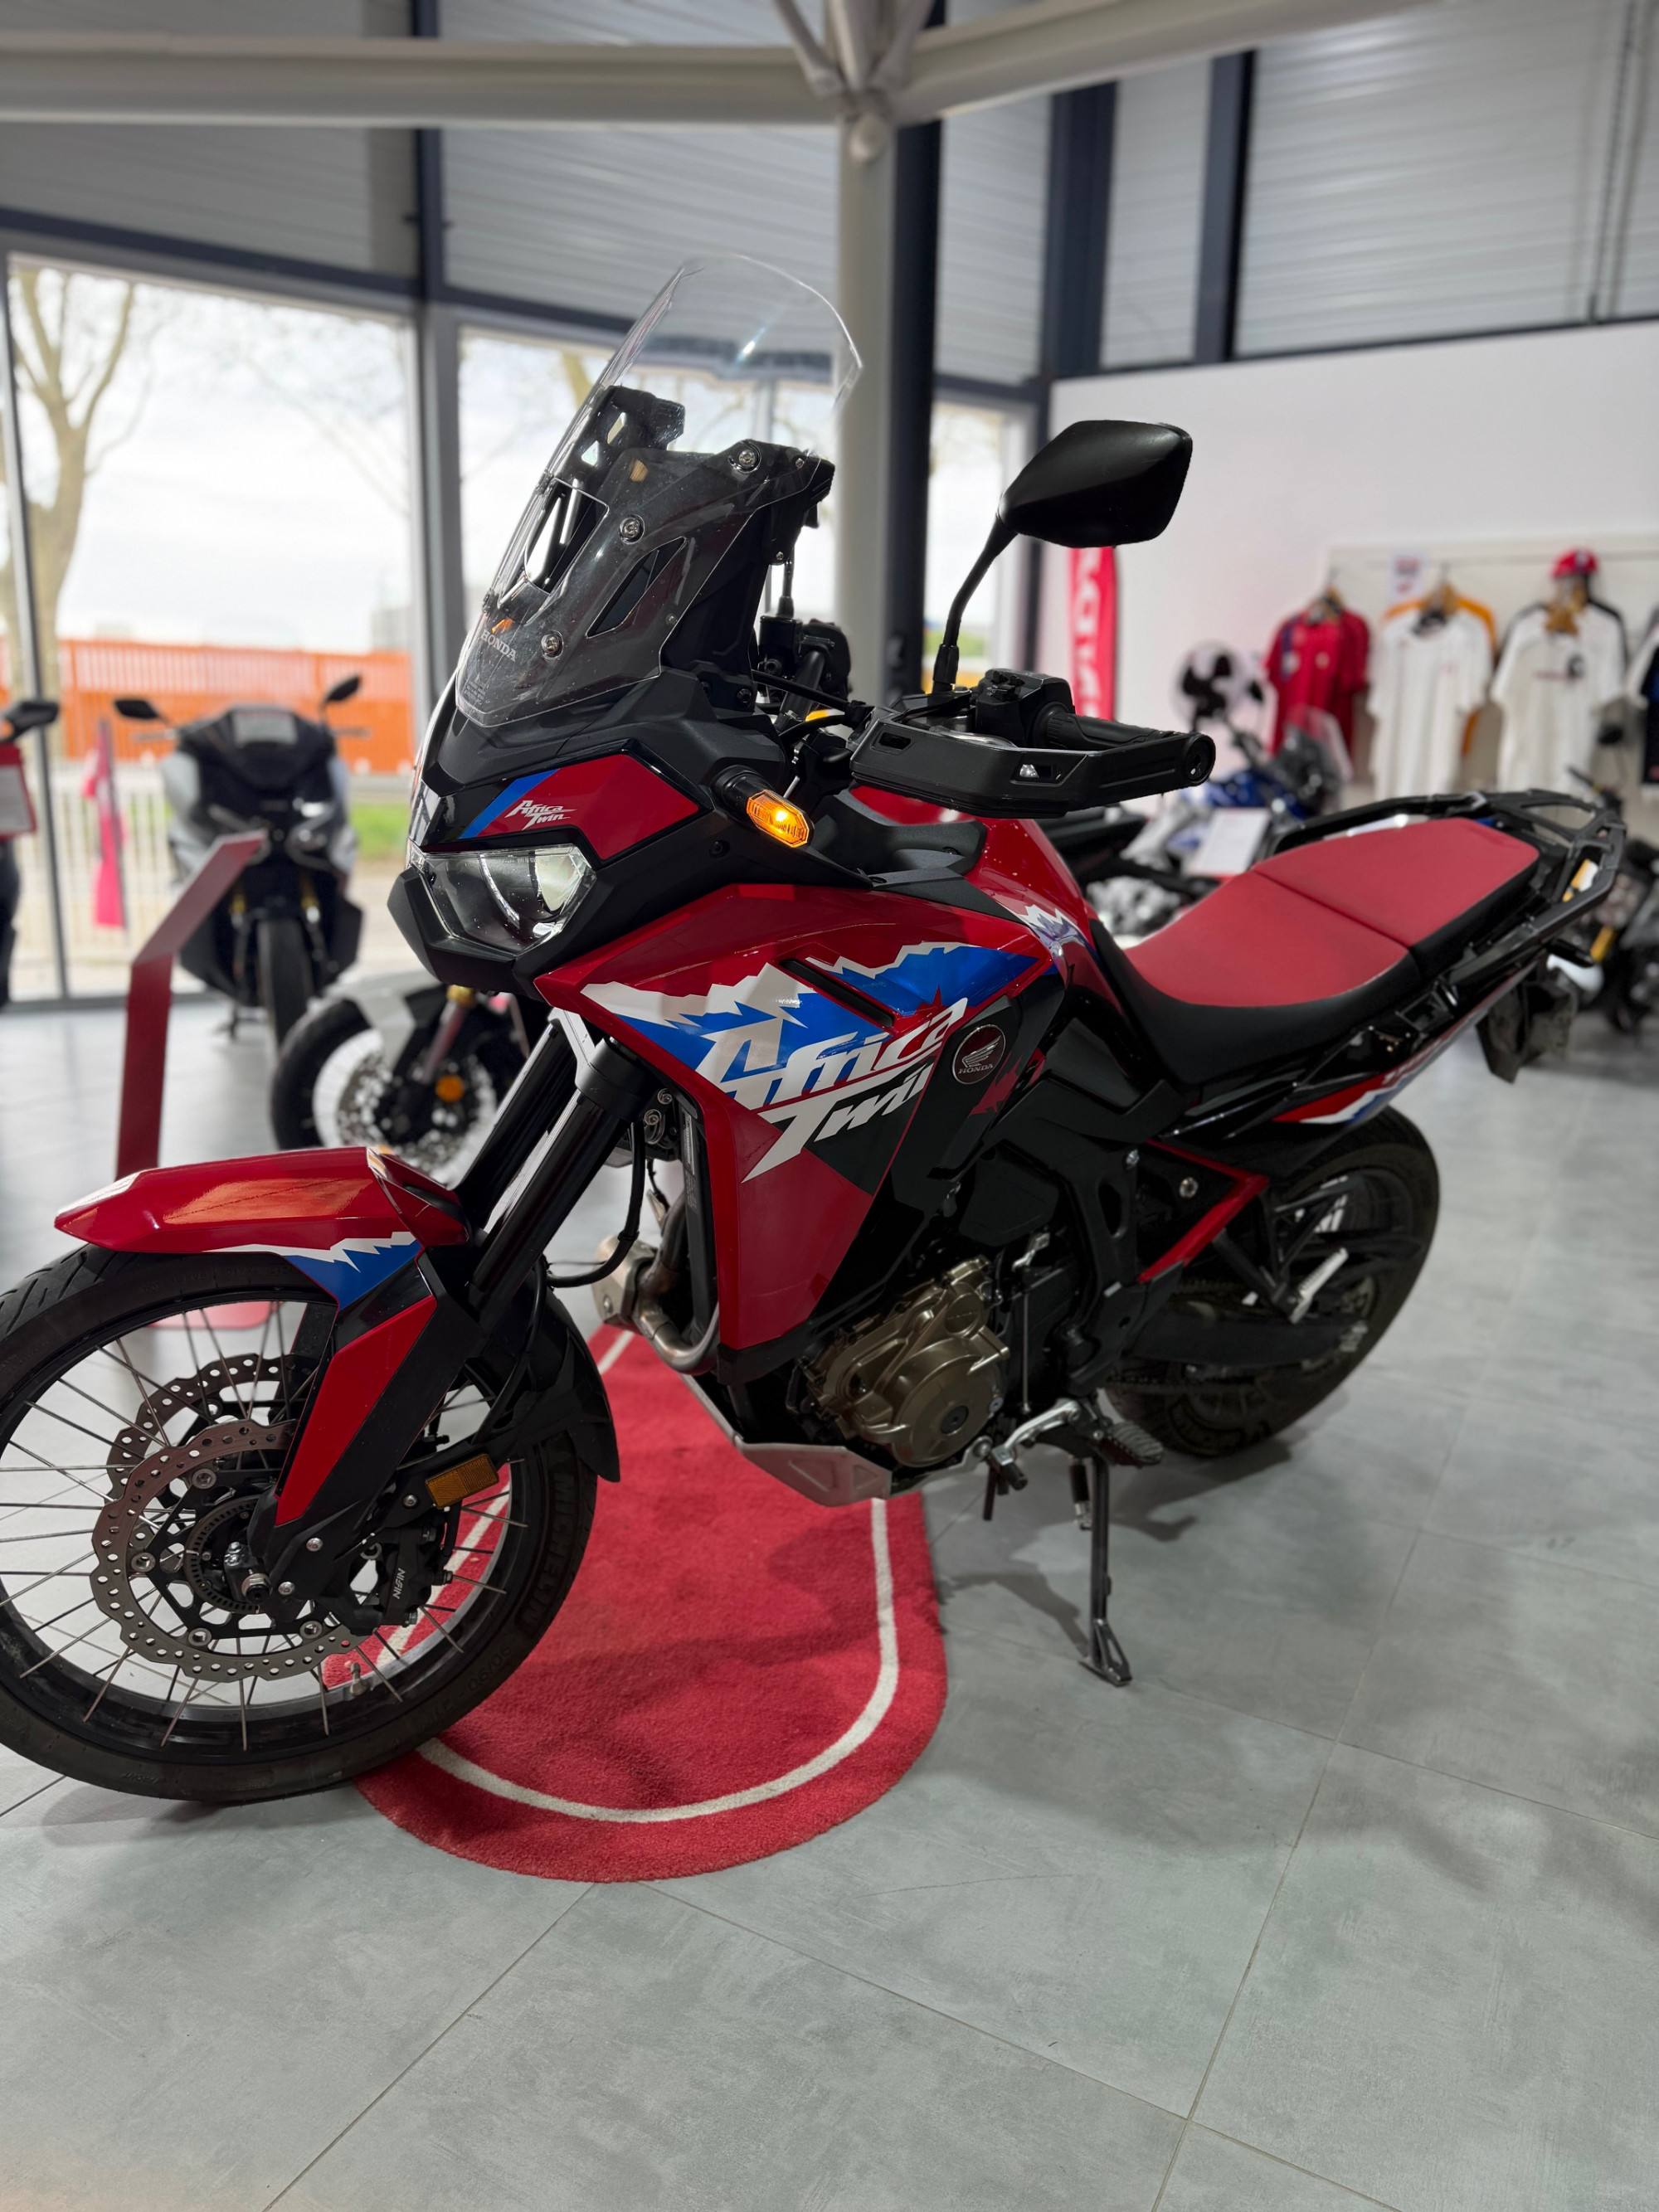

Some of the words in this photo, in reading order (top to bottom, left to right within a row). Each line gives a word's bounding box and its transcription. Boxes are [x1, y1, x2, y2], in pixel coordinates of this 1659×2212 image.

[480, 630, 517, 662] HONDA
[504, 800, 564, 819] Africa
[696, 997, 969, 1110] Africa
[958, 1062, 994, 1074] HONDA
[521, 1473, 575, 1626] MICHELIN
[392, 1567, 406, 1600] NISSIN
